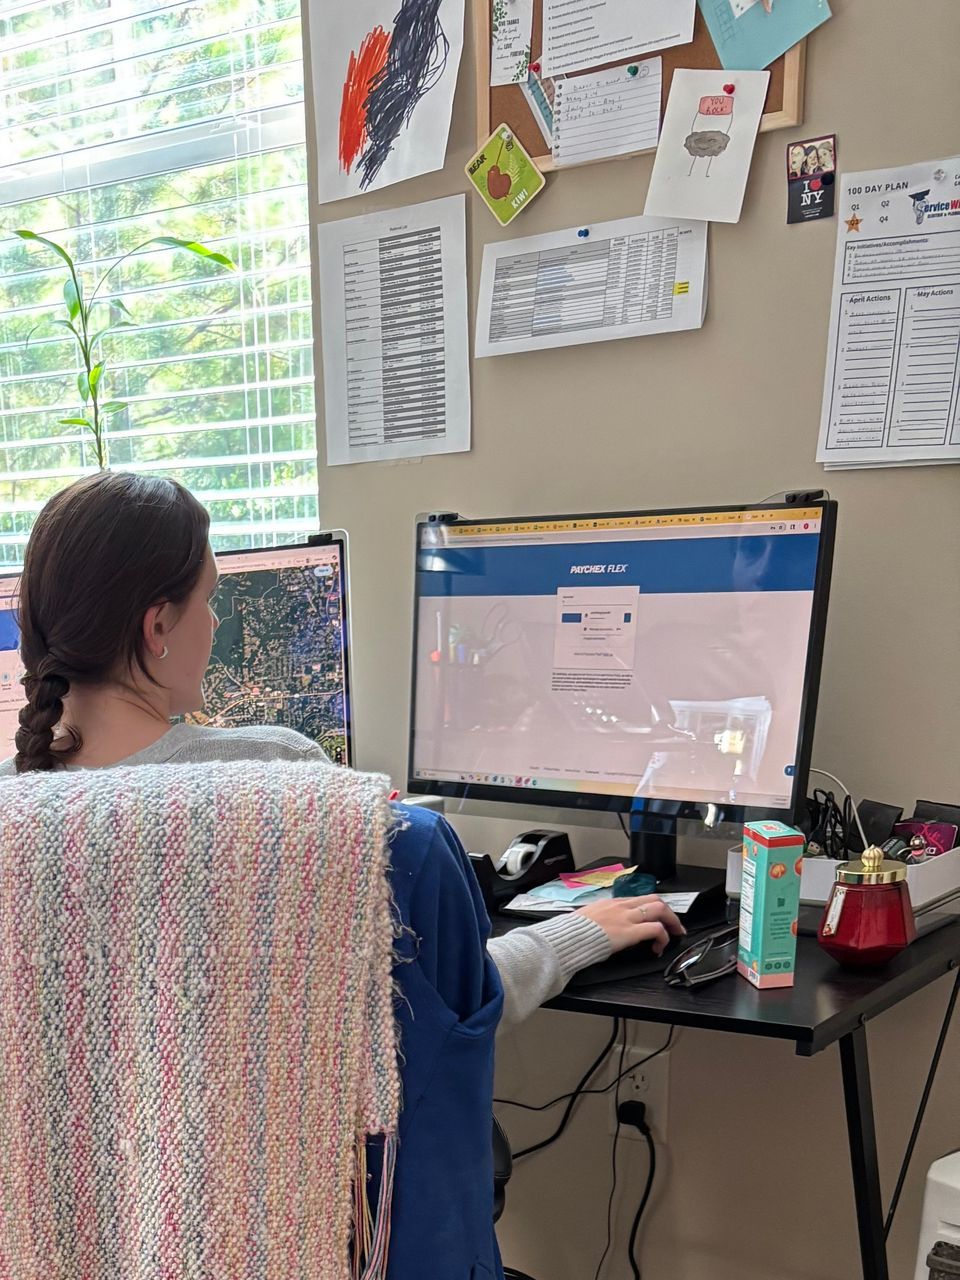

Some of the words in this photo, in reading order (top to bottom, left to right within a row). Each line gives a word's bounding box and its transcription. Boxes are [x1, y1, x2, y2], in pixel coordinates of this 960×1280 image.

[848, 187, 862, 195] 100
[865, 184, 883, 193] DAY
[885, 181, 909, 191] PLAN
[511, 188, 528, 209] KIWI
[801, 190, 825, 206] NY
[881, 200, 890, 208] Q2
[931, 289, 954, 297] Actions
[866, 295, 891, 303] Actions
[570, 565, 606, 574] PAYCHEX
[607, 564, 628, 573] FLEX
